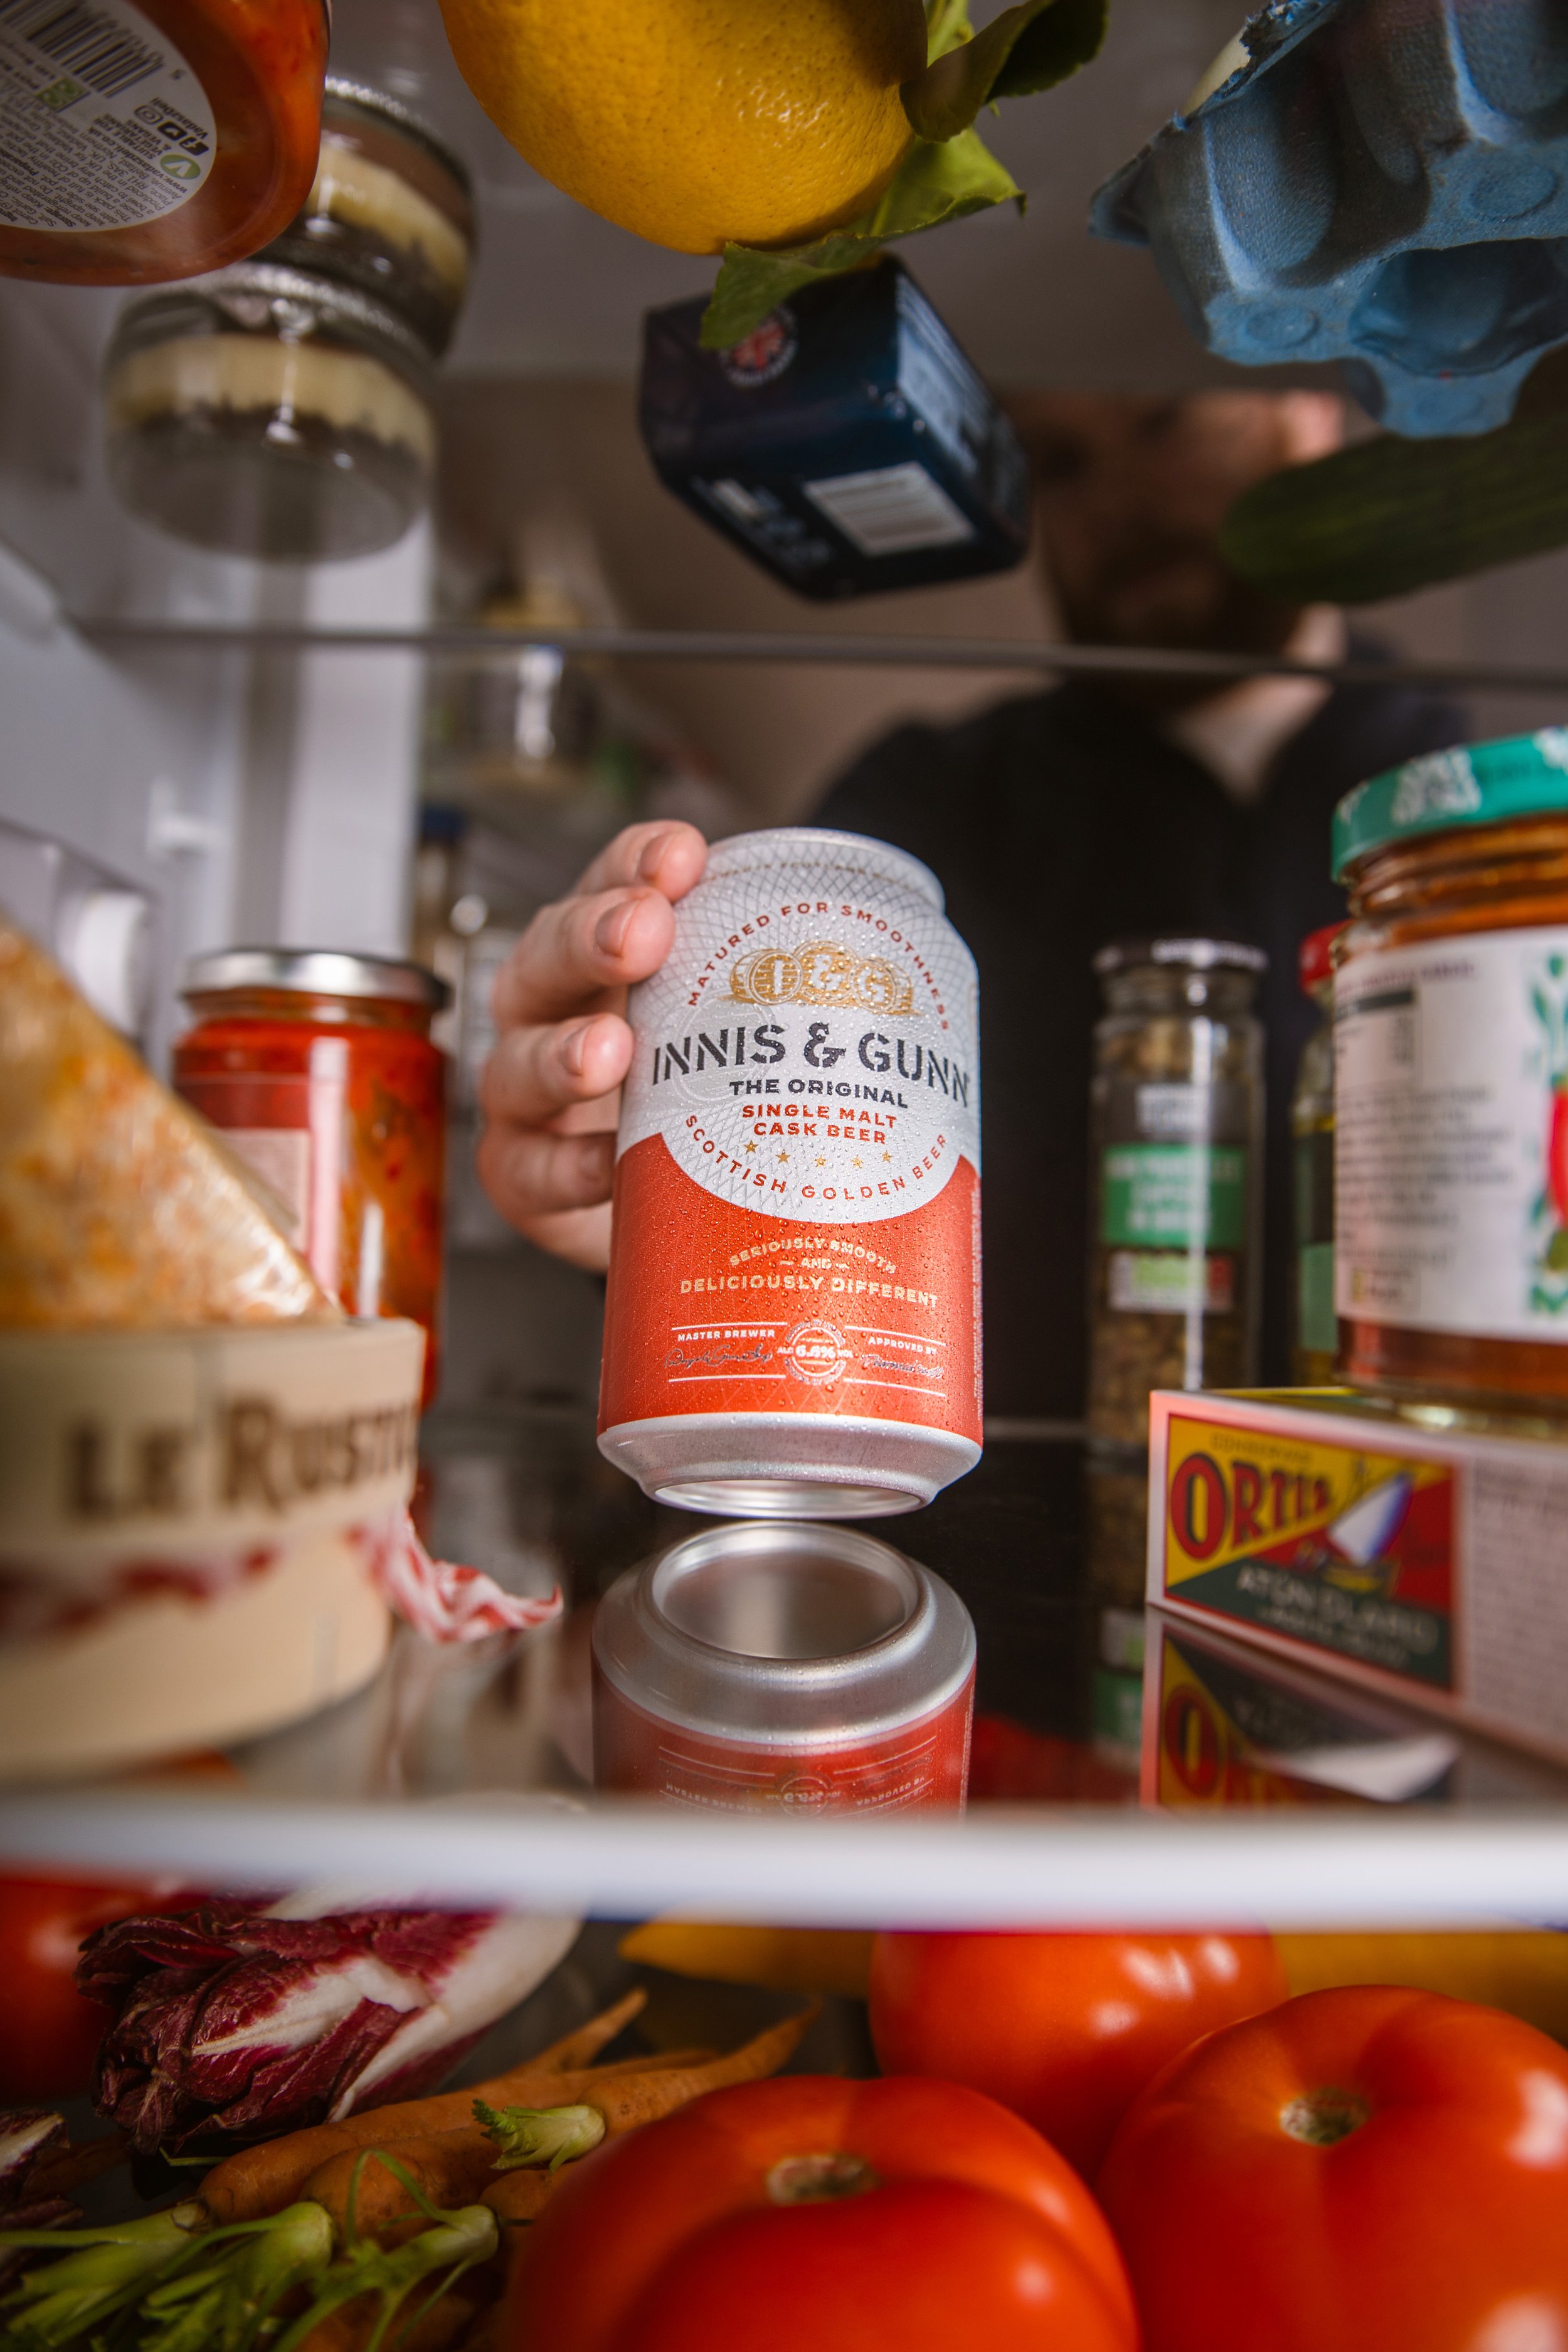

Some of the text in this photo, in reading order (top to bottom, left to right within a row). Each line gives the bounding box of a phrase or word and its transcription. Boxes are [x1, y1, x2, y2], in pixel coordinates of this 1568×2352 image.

[149, 96, 208, 138] VadaszDeli
[102, 114, 162, 154] VEGETARIANS
[124, 119, 161, 144] VEGANS
[78, 133, 117, 159] Northern
[112, 130, 156, 159] SUITABLE
[38, 152, 50, 160] in
[72, 151, 88, 161] for
[87, 126, 188, 193] www.vadaszdeli.co.uk
[26, 154, 61, 177] healthy
[77, 164, 96, 177] any
[85, 160, 103, 171] UK
[117, 157, 150, 179] Belfast,
[4, 173, 24, 186] and
[23, 175, 40, 185] not
[39, 173, 58, 186] pot.
[57, 174, 70, 183] of
[65, 169, 79, 178] of
[77, 175, 92, 185] up
[101, 169, 118, 180] the
[38, 184, 53, 194] Do
[55, 185, 67, 193] of
[68, 181, 85, 193] full
[88, 184, 114, 200] build
[93, 177, 118, 193] catch
[149, 178, 183, 200] Avenue,
[19, 191, 45, 208] Keep
[22, 183, 72, 215] refrigerated
[65, 191, 86, 204] side
[93, 196, 116, 210] pack
[125, 185, 164, 210] Produced
[125, 197, 147, 211] bowl
[147, 188, 173, 205] Place,
[84, 202, 100, 212] see
[120, 203, 144, 218] cause
[11, 208, 38, 225] Carrot
[42, 205, 77, 227] Storage:
[70, 213, 92, 226] keep
[84, 211, 106, 226] keep
[98, 212, 118, 225] date
[113, 210, 132, 221] This
[689, 902, 949, 1030] MATURED FOR SMOOTHNESS
[653, 1021, 970, 1108] INNIS & GUNN
[729, 1079, 908, 1109] THE ORIGINAL
[742, 1104, 898, 1129] SINGLE MALT
[753, 1122, 887, 1144] CASK BEER
[686, 1114, 947, 1201] SCOTTISH GOLDEN BEER
[729, 1236, 897, 1274] SERIOUSLY SMOOTH
[801, 1257, 832, 1269] AND
[681, 1275, 938, 1308] DELICIOUSLY DIFFERENT
[677, 1330, 720, 1341] MASTER
[724, 1329, 775, 1338] BREWER
[776, 1346, 794, 1354] ALC
[837, 1349, 854, 1358] VOL
[868, 1336, 937, 1356] APPROVED BY
